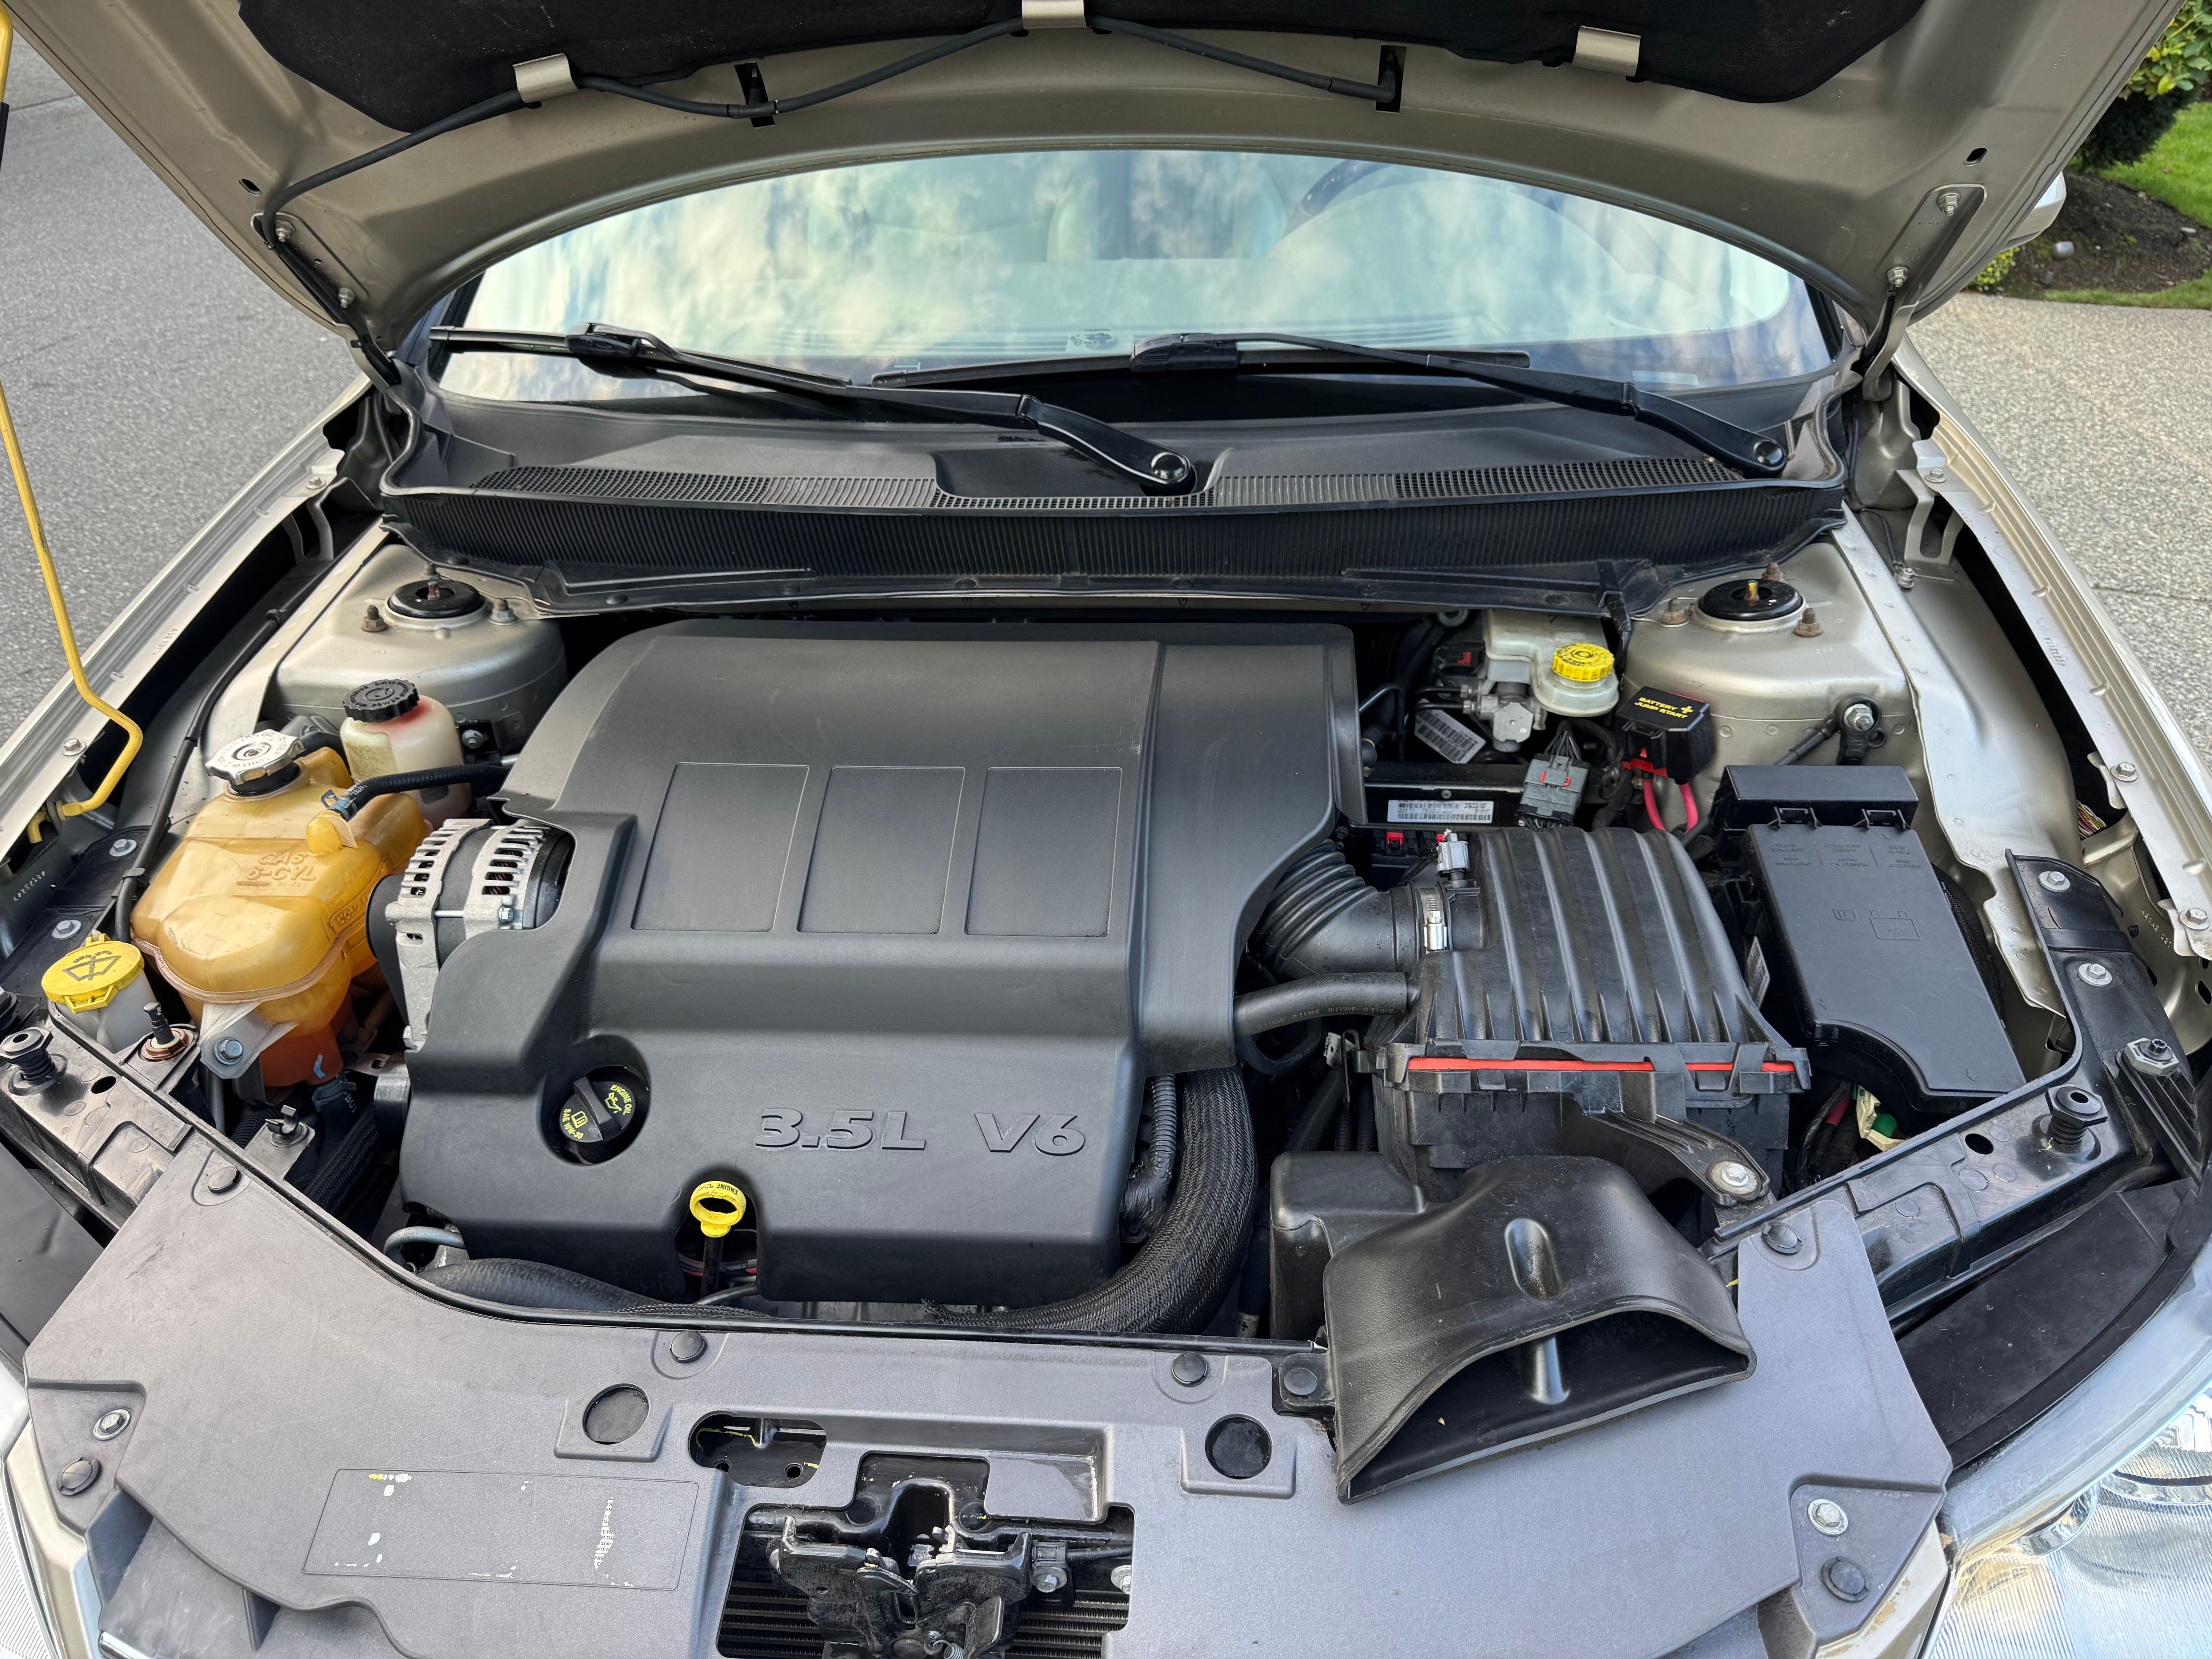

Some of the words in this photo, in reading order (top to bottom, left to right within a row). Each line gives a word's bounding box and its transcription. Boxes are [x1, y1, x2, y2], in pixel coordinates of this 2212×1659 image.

[1634, 702, 1659, 711] JUMP
[1659, 708, 1688, 719] START
[1638, 697, 1678, 711] BATTERY
[258, 852, 308, 865] GAS
[246, 865, 316, 881] 6-CYL
[610, 1084, 632, 1103] ENGINE
[622, 1103, 632, 1115] OIL
[562, 1108, 572, 1122] SAE
[563, 1122, 584, 1140] 10W-30
[754, 1107, 926, 1151] 3.5L
[974, 1112, 1086, 1157] V6
[716, 1183, 738, 1195] ENGINE
